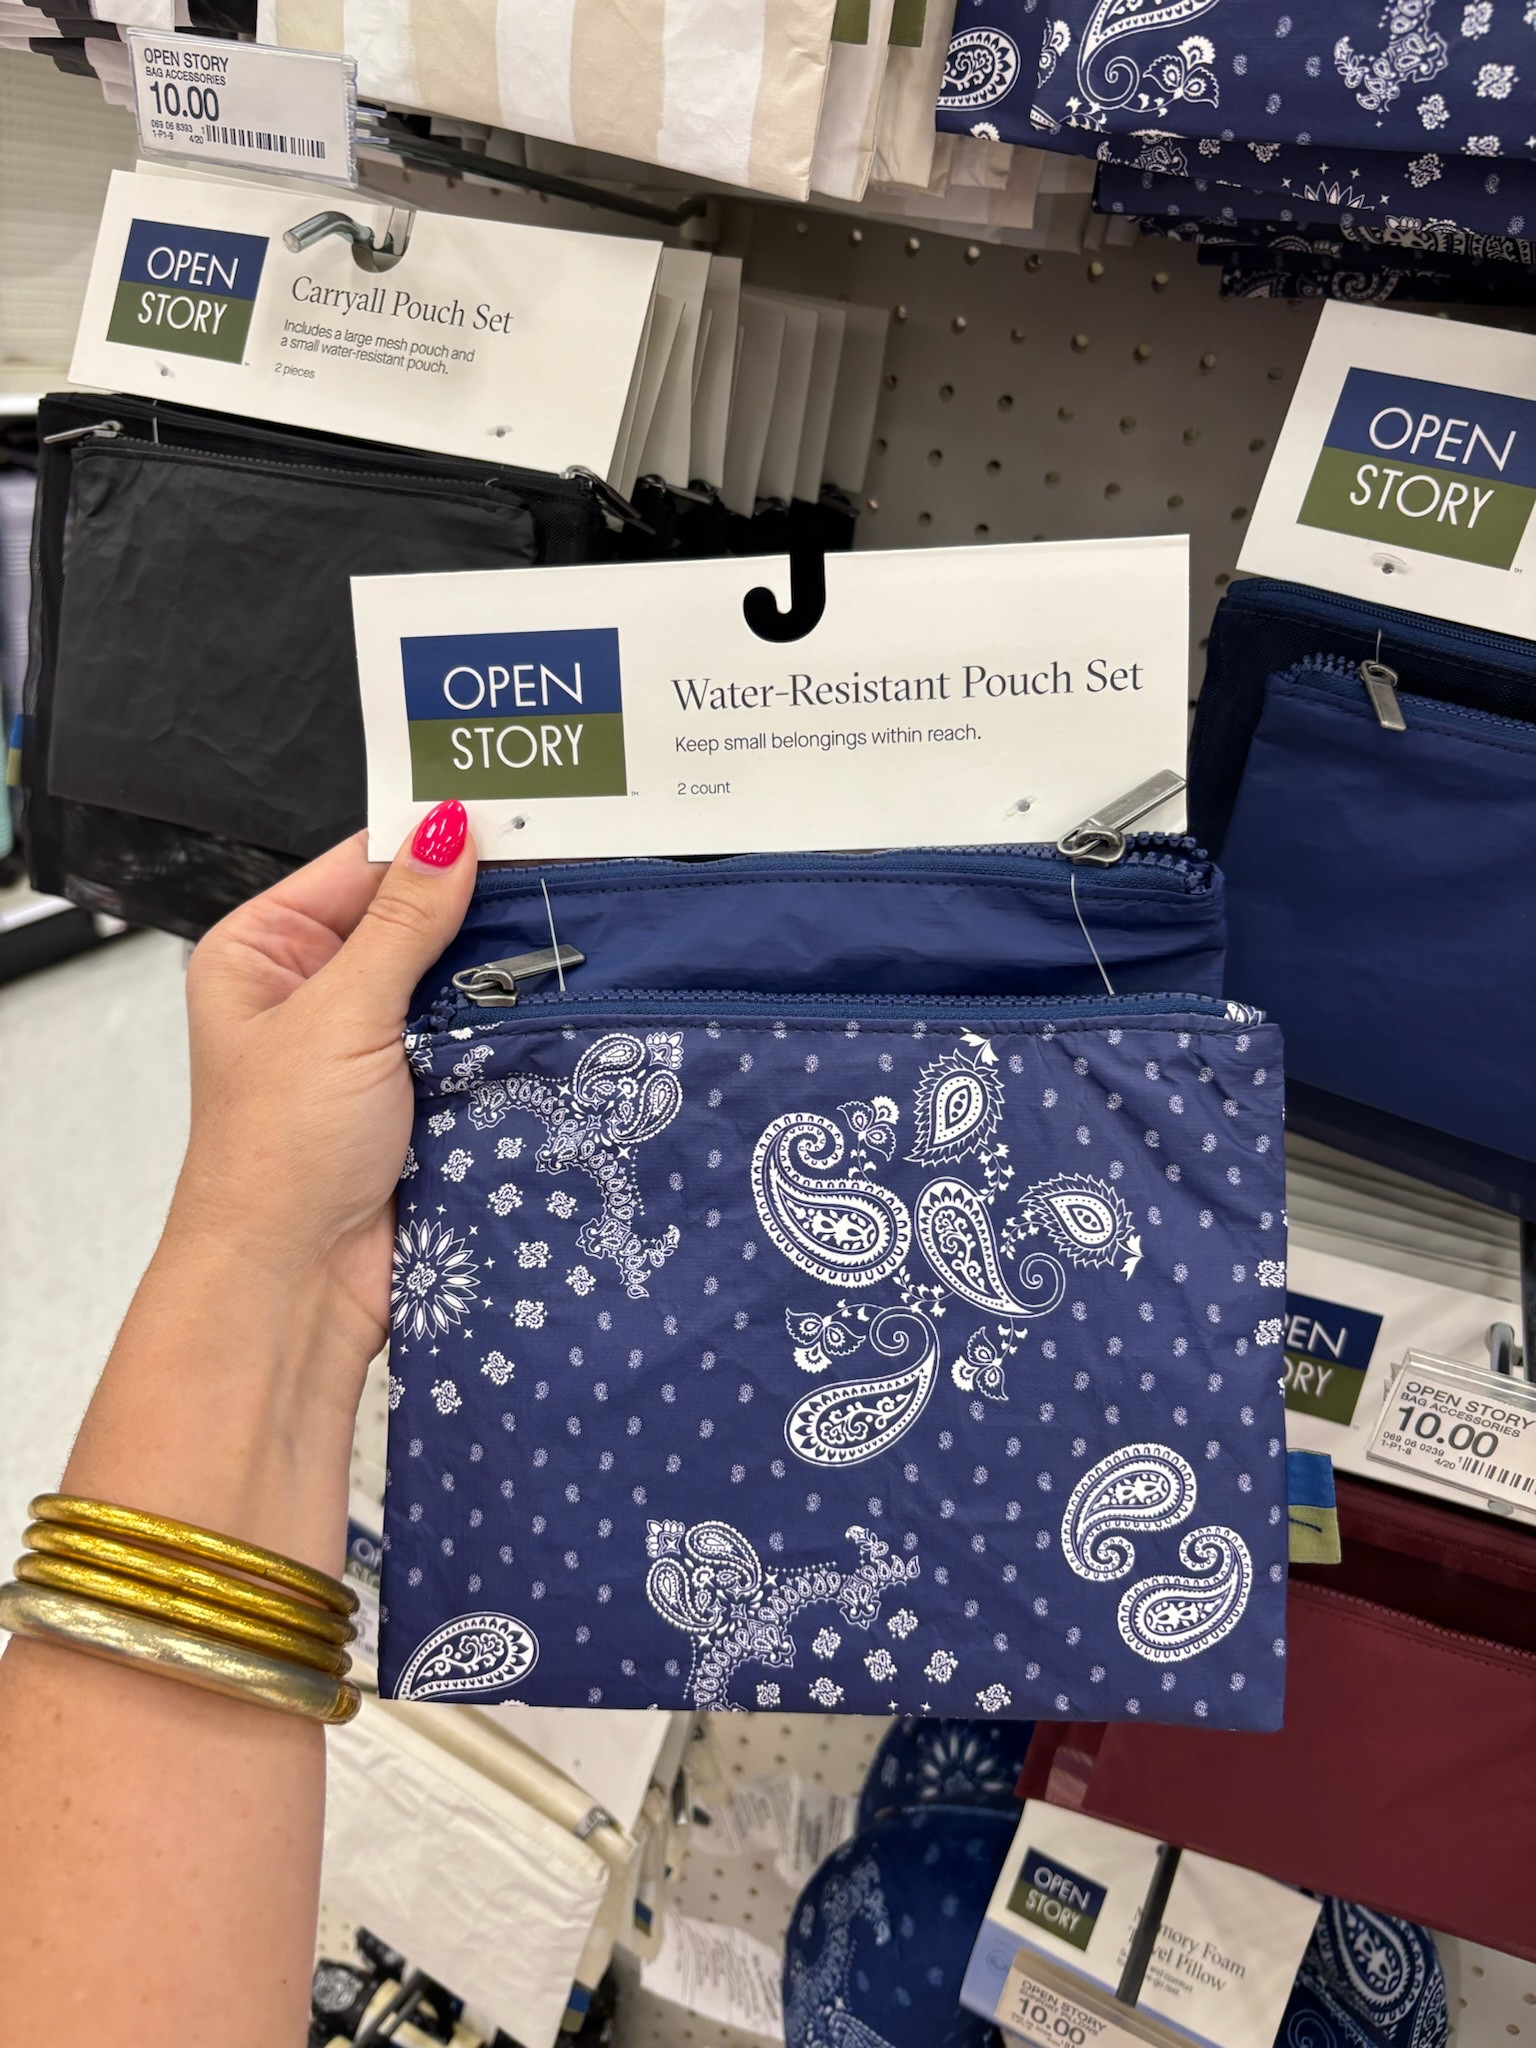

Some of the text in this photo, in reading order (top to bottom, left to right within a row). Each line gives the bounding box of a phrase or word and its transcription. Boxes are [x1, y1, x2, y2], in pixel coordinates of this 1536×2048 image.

[143, 47, 230, 73] OPEN STORY
[145, 66, 227, 86] BAG ACCESSORIES
[149, 80, 220, 122] 10.00
[146, 245, 240, 291] OPEN
[137, 290, 230, 336] STORY
[291, 275, 514, 334] Carryall Pouch Set
[280, 336, 449, 376] a small water-resistant pouch.
[283, 318, 476, 363] Includes a large mesh pouch and
[274, 362, 316, 380] 2 pieces
[1368, 406, 1518, 473] OPEN
[1348, 462, 1496, 530] STORY
[442, 661, 583, 711] OPEN
[670, 658, 1145, 713] Water-Resistant Pouch Set
[450, 723, 584, 771] STORY
[675, 723, 982, 756] Keep small belongings within reach.
[677, 780, 731, 796] 2 count
[1284, 1311, 1348, 1359] EN
[1400, 1391, 1521, 1438] BAG ACCESSORIES
[1405, 1380, 1536, 1431] OPEN STORY
[1383, 1430, 1402, 1443] 069
[1404, 1437, 1418, 1448] 06
[1419, 1442, 1445, 1457] 0239
[1398, 1405, 1500, 1459] 10.00
[1434, 1457, 1457, 1470] 4/20
[1025, 1888, 1081, 1934] STORY
[1033, 1865, 1092, 1912] OPEN
[1175, 1952, 1228, 1993] Pillow
[1202, 1941, 1247, 1980] Foam
[1018, 1997, 1086, 2046] 10.00
[1021, 1979, 1059, 2006] OPEN
[1060, 2001, 1108, 2032] STORY
